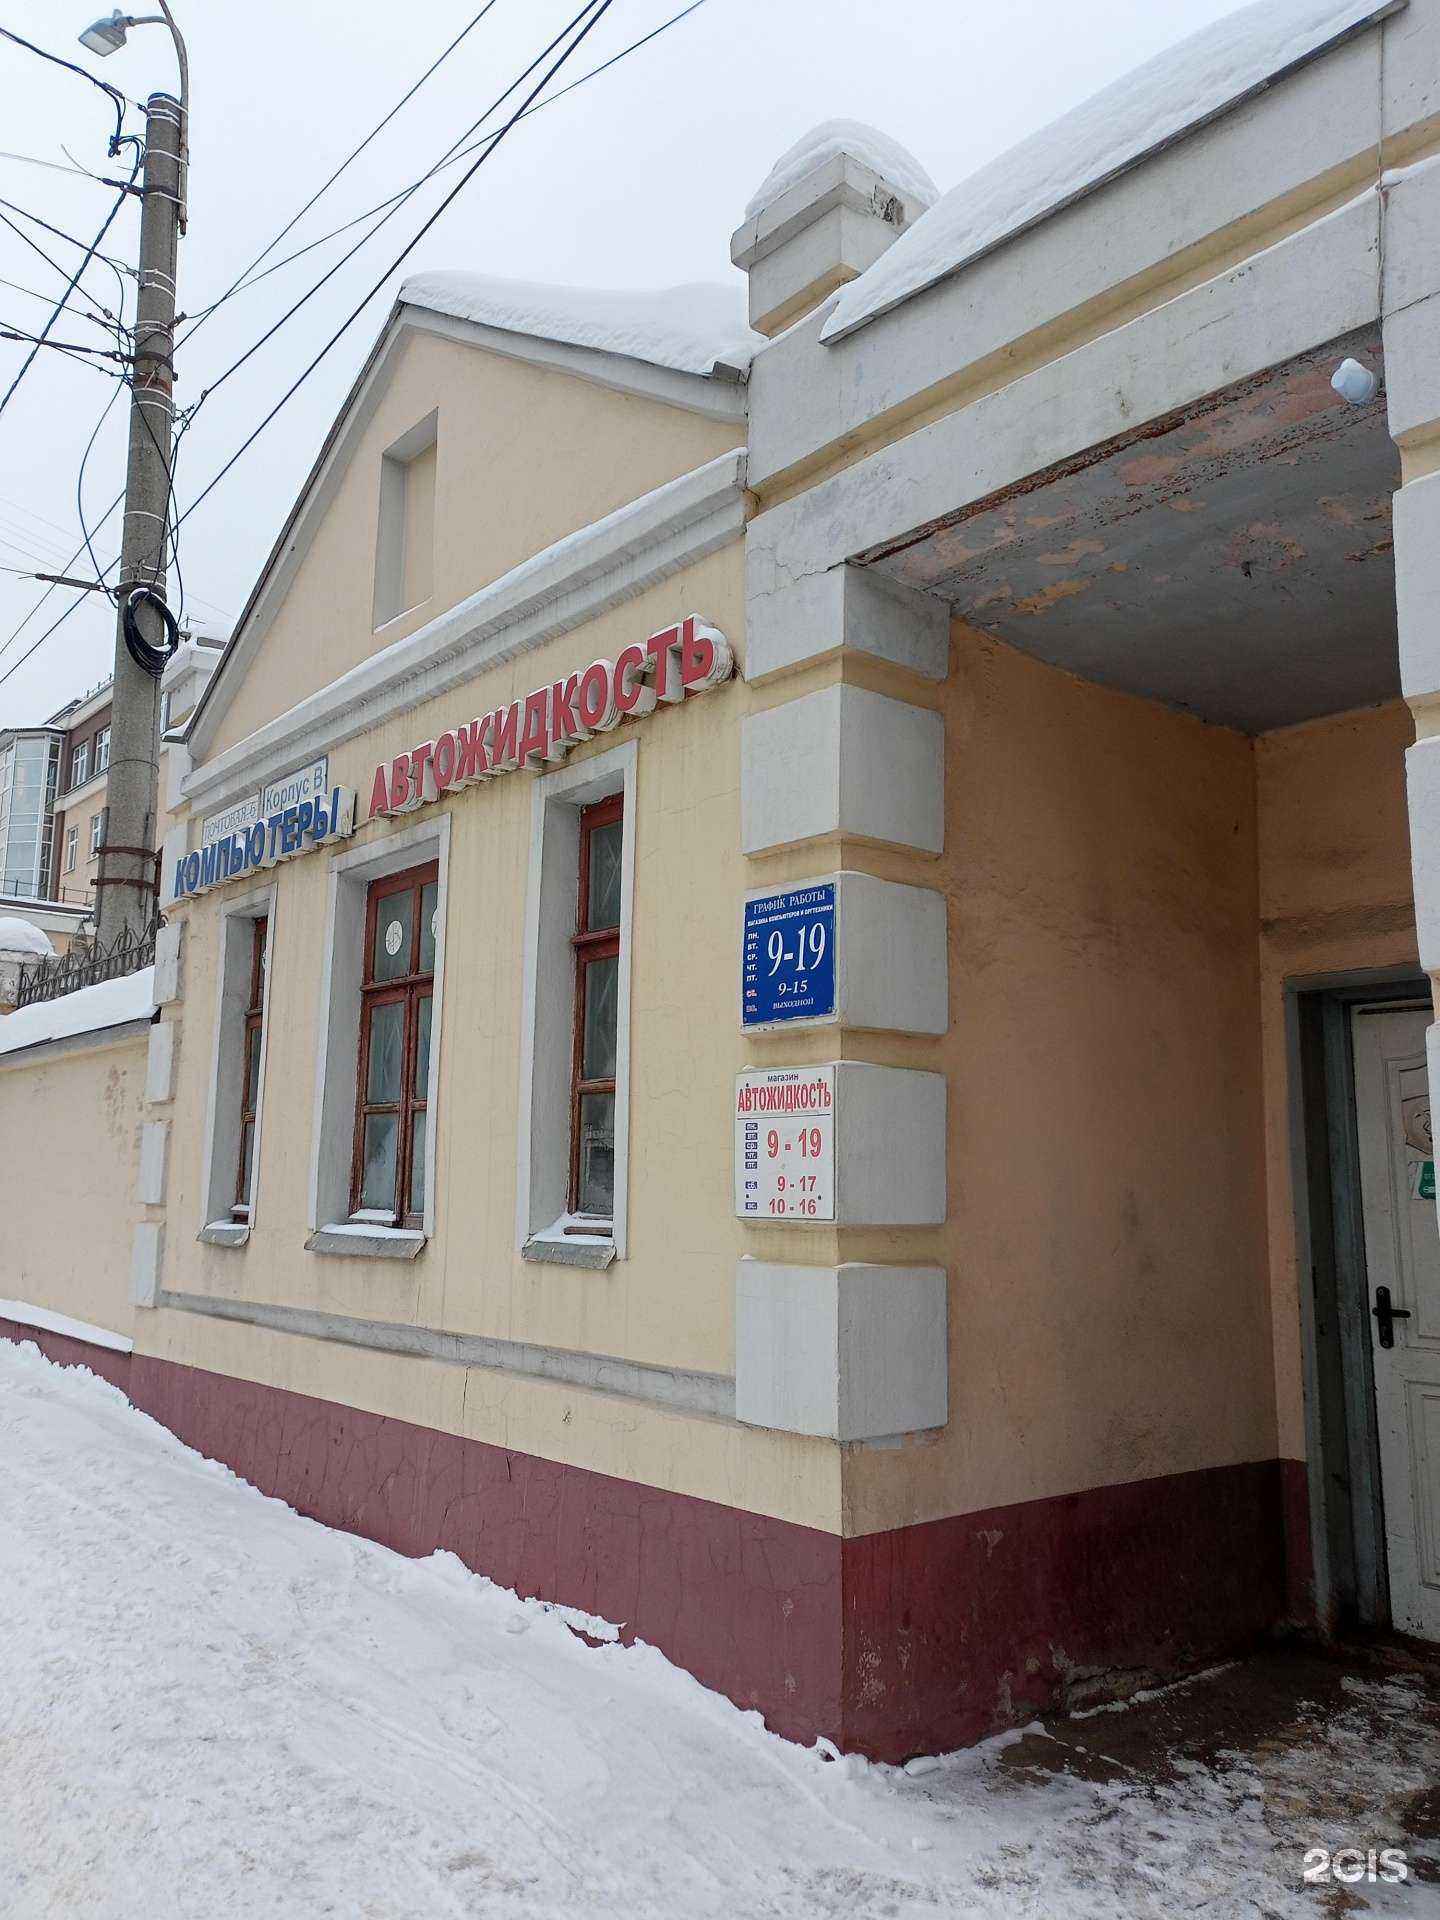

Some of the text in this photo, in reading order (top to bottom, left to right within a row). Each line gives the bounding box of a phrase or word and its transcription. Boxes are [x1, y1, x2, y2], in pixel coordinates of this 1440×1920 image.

[368, 614, 715, 818] АВТОЖИДКОСТЬ
[266, 777, 309, 811] Корпус
[174, 786, 341, 898] КОМПЬЮТЕРЫ
[753, 889, 825, 914] ГРАФИК РАБОТЫ
[768, 922, 826, 976] 9-19
[778, 980, 808, 996] 9-15
[767, 1072, 799, 1083] магазин
[738, 1082, 832, 1112] АВТОЖИДКОСТЬ
